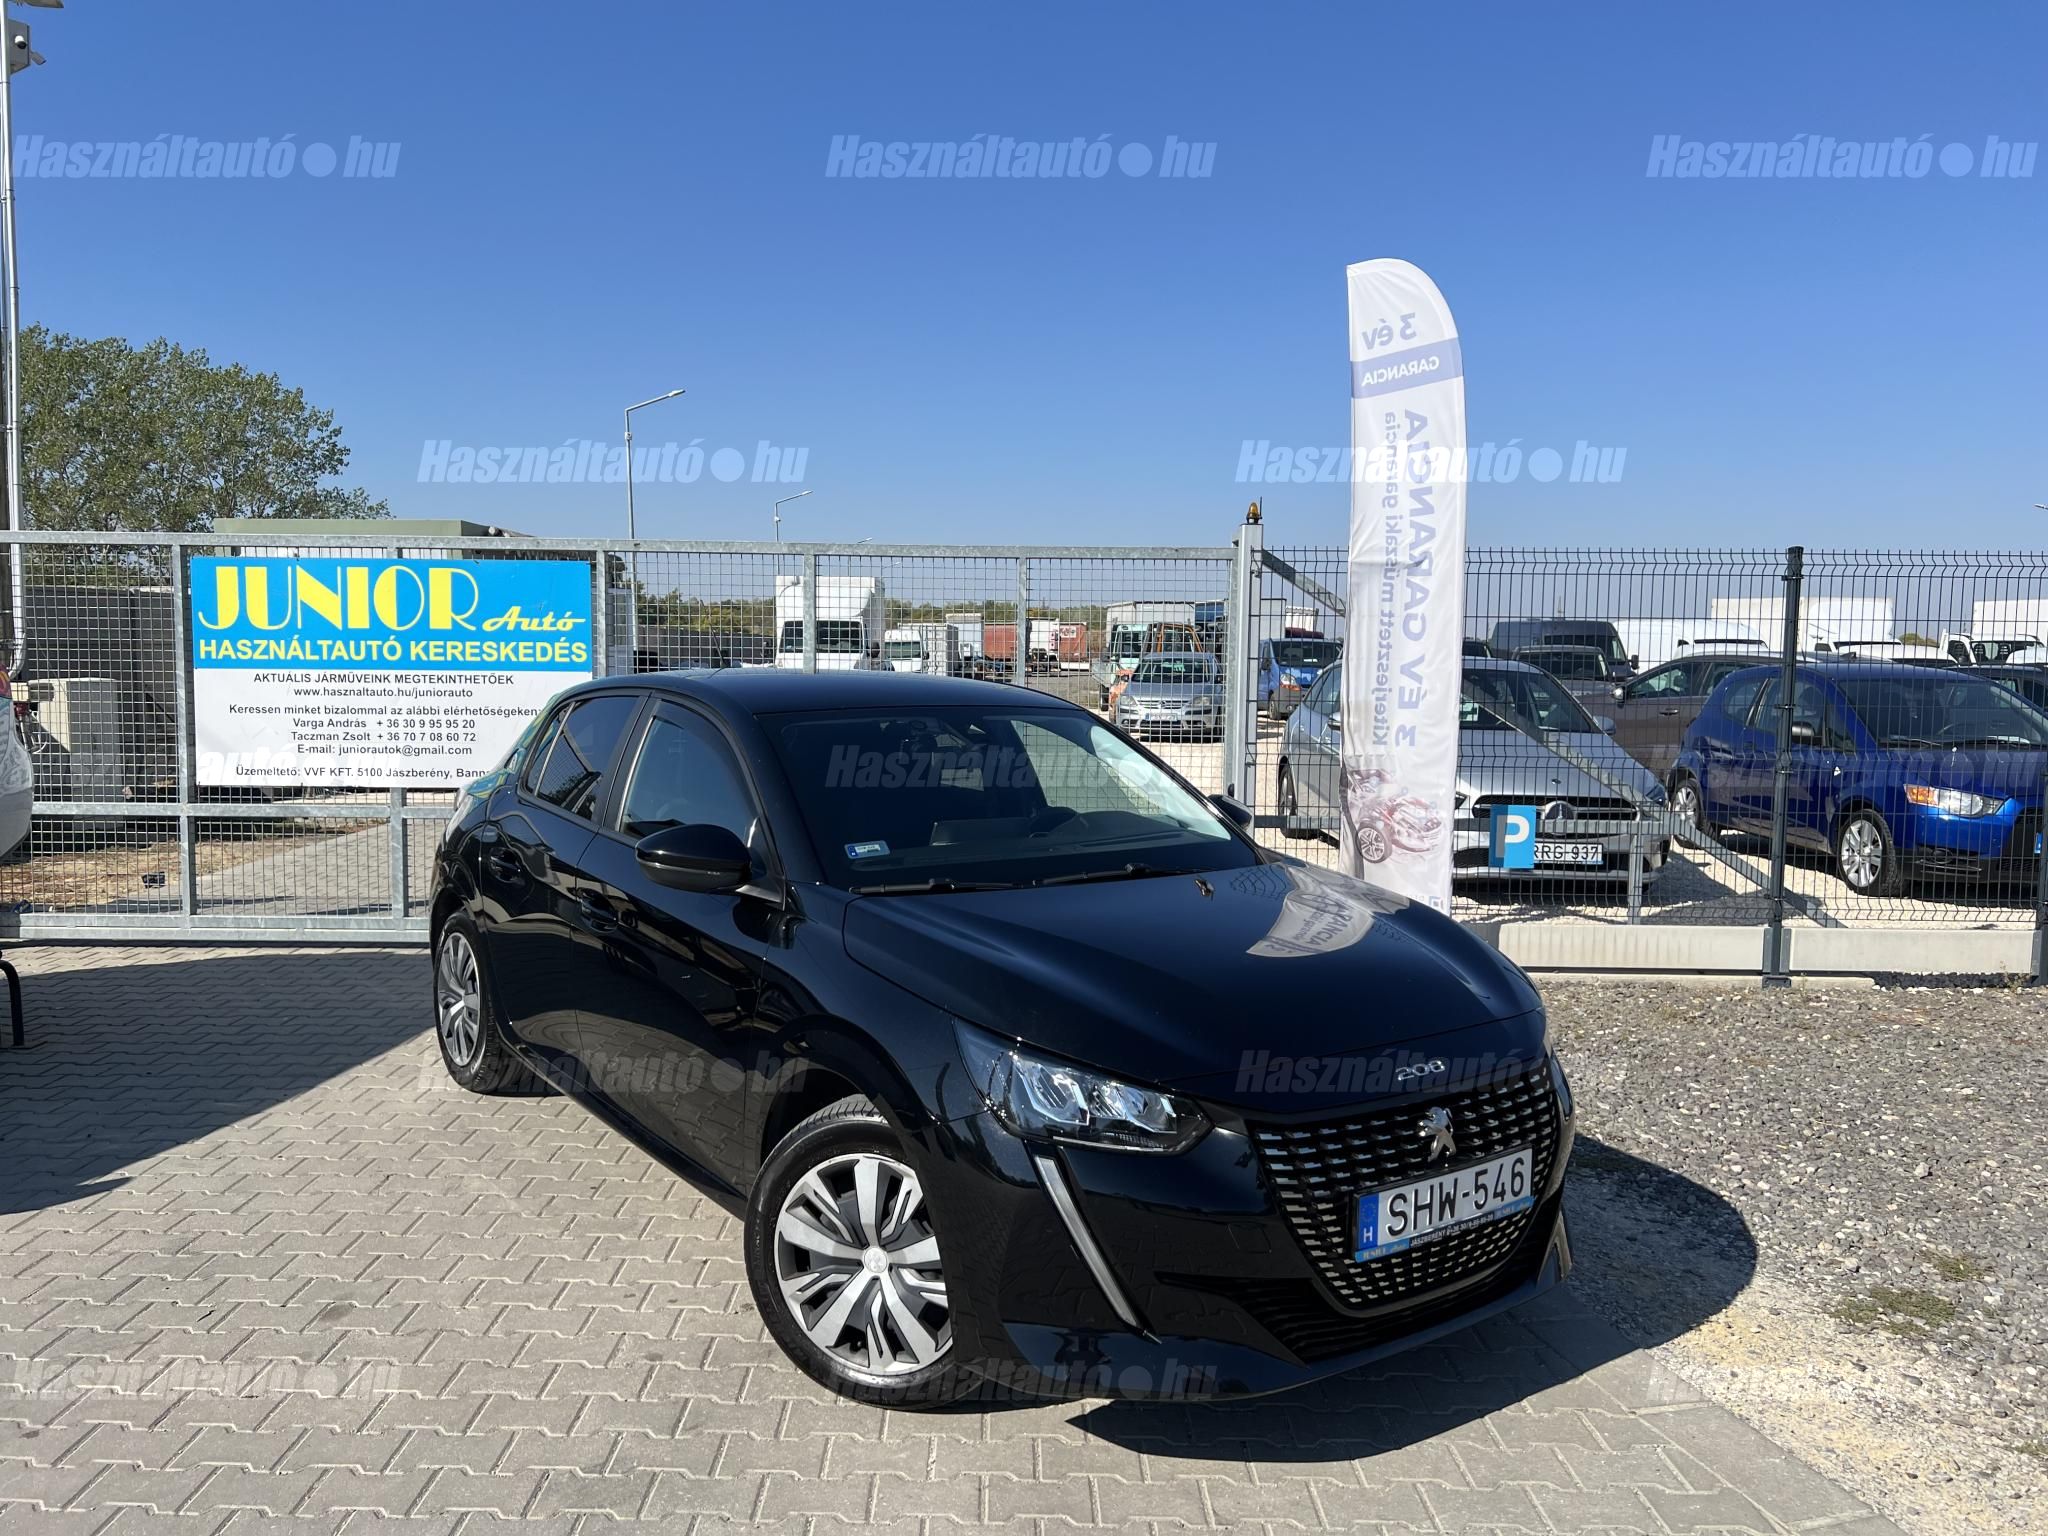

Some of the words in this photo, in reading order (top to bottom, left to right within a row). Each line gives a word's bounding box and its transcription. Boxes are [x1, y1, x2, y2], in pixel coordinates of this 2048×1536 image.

[198, 565, 479, 631] JUNIOR
[482, 606, 586, 631] Autó
[200, 634, 402, 661] HASZNÁLTAUTÓ
[410, 636, 587, 662] KERESKEDÉS
[254, 671, 312, 683] AKTUÁLIS
[314, 671, 391, 683] JÁRMŰVEINK
[394, 673, 514, 685] MEGTEKINTHETŐEK
[293, 687, 473, 699] www.hasznaltauto.hu/juniorauto
[229, 704, 281, 714] Keressen
[284, 704, 321, 714] minket
[324, 705, 387, 715] bizalommal
[390, 707, 403, 715] az
[406, 706, 440, 715] alábbi
[293, 718, 324, 729] Varga
[327, 718, 367, 728] András
[386, 719, 399, 728] 36
[402, 719, 416, 728] 30
[418, 719, 426, 728] 9
[428, 719, 442, 728] 95
[445, 719, 459, 728] 95
[462, 719, 475, 728] 20
[291, 731, 339, 741] Taczman
[342, 731, 371, 741] Zsolt
[386, 732, 400, 741] 36
[403, 732, 416, 741] 70
[419, 732, 426, 741] 7
[429, 732, 443, 741] 08
[446, 732, 459, 741] 60
[463, 732, 476, 742] 72
[297, 744, 336, 754] E-mail:
[338, 744, 472, 756] juniorautok@gmail.com
[236, 764, 301, 776] Üzemeltető:
[304, 767, 326, 776] VVF
[329, 767, 354, 776] KFT.
[357, 767, 383, 777] 5100
[386, 768, 453, 779] Jászberény,
[1496, 815, 1530, 858] P
[1396, 1059, 1447, 1081] 208
[1386, 1156, 1525, 1237] SHW-546
[1363, 1226, 1373, 1243] H
